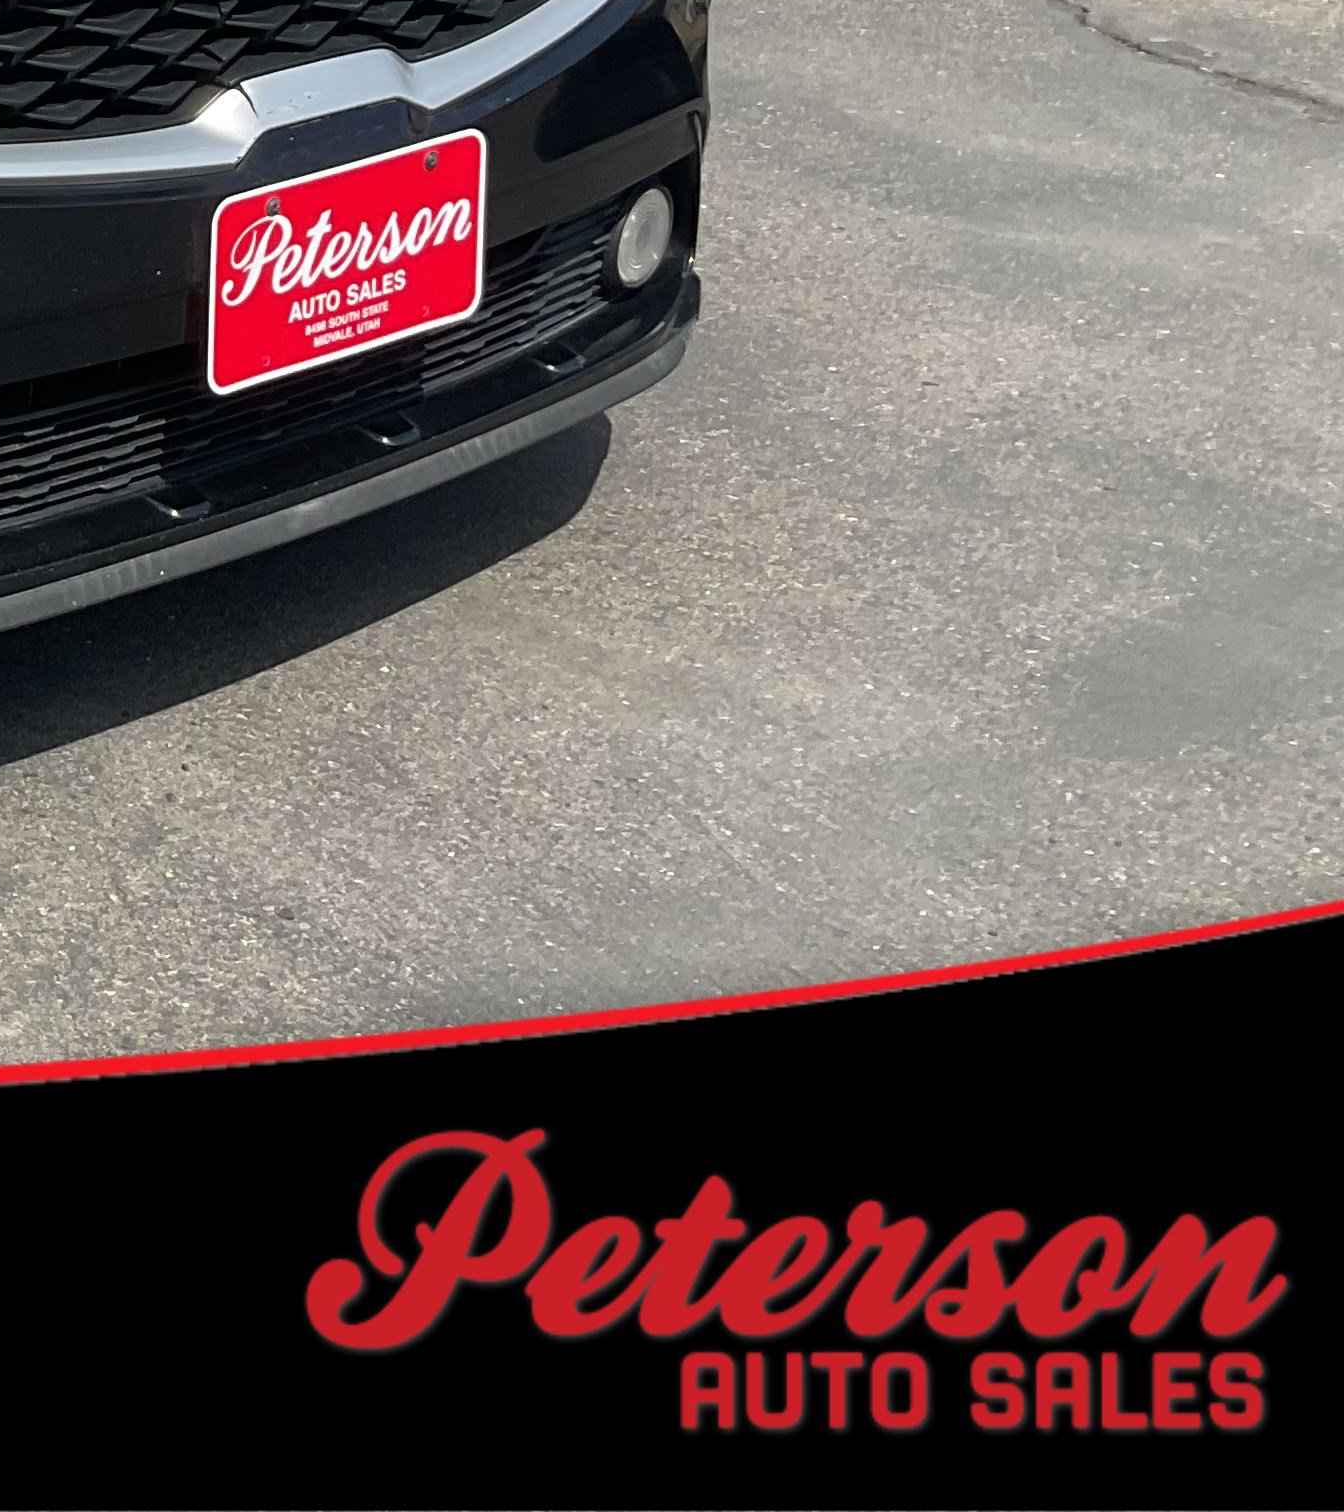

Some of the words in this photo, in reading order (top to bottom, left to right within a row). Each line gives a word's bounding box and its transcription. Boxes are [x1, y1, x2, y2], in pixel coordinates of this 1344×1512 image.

[221, 197, 473, 307] Peterson
[288, 289, 341, 324] AUTO
[346, 269, 407, 306] SALES
[328, 310, 360, 329] SOUTH
[362, 300, 389, 318] STATE
[356, 316, 381, 335] UTAH
